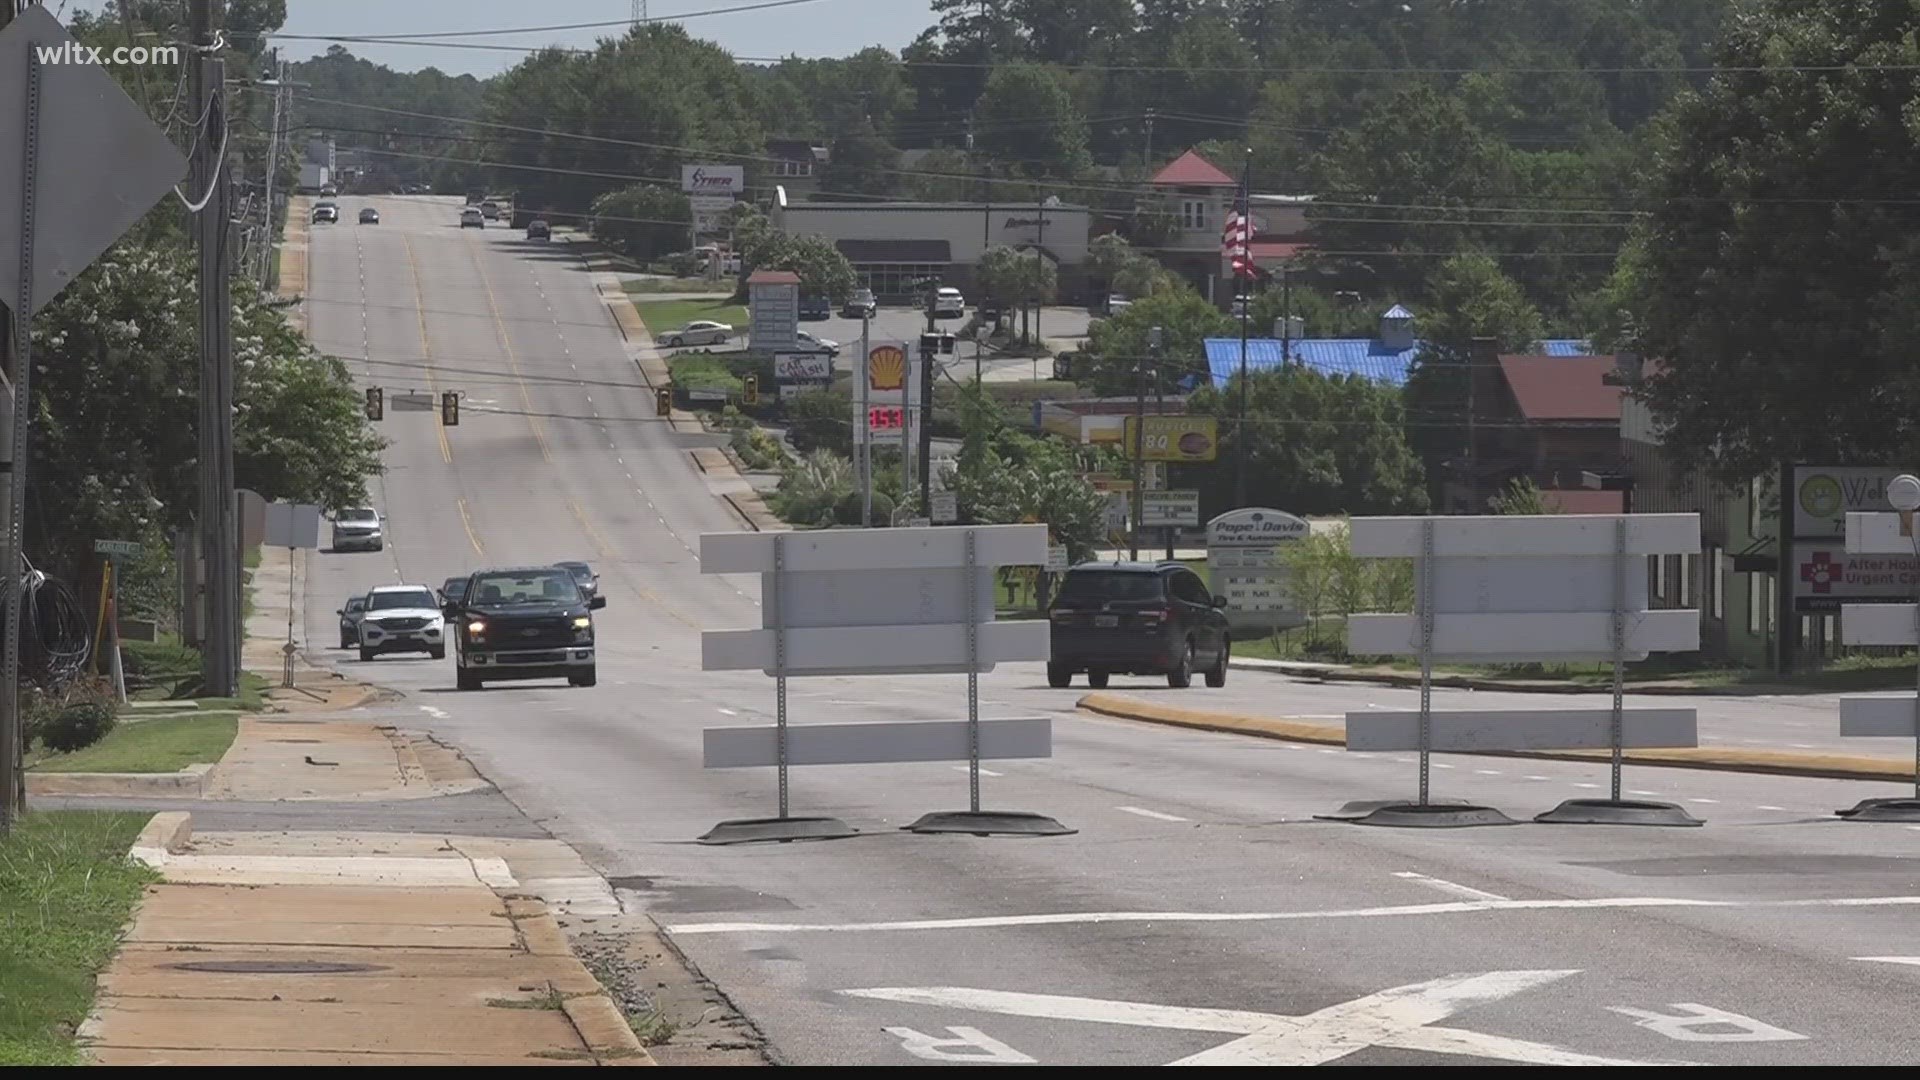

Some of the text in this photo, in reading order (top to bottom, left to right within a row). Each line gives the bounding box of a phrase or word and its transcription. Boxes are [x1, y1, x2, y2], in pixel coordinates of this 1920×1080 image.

[789, 363, 825, 377] WASH
[1841, 475, 1888, 507] Wel
[1216, 521, 1304, 534] Pope Davis
[1849, 558, 1885, 570] After
[1846, 572, 1895, 584] Urgent
